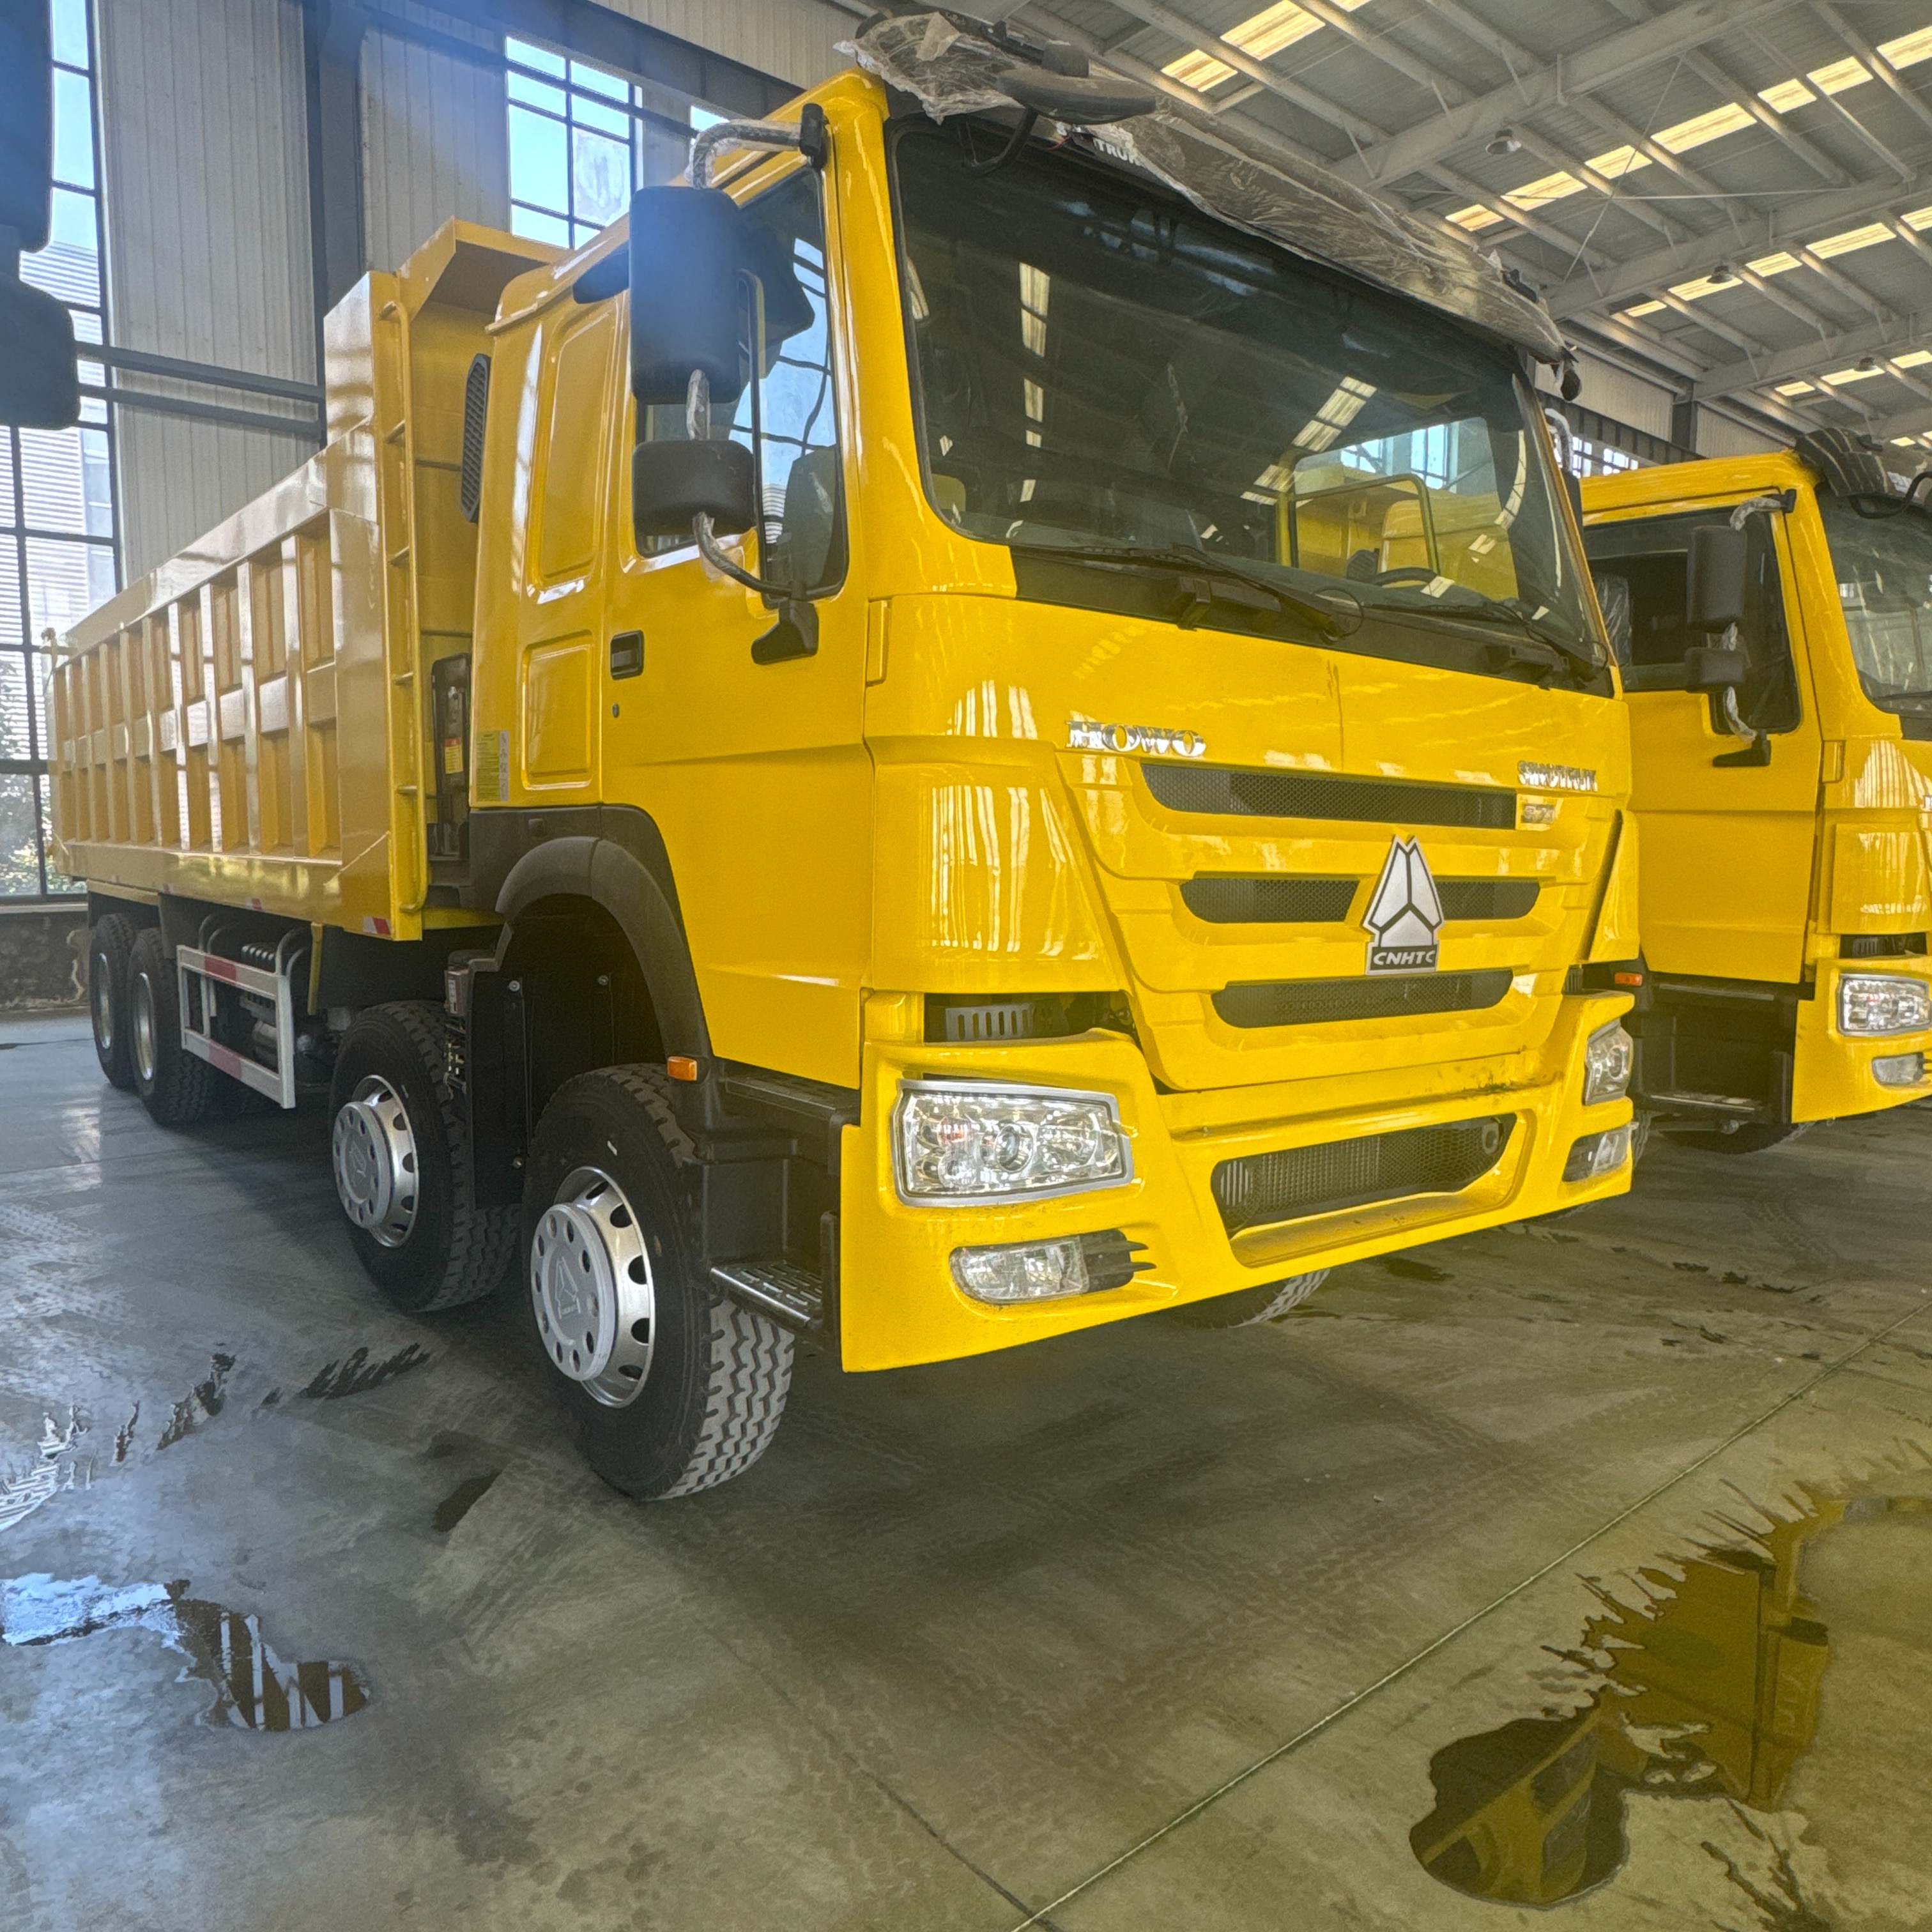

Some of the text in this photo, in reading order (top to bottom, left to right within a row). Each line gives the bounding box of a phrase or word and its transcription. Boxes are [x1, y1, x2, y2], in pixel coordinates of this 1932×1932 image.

[1093, 137, 1140, 165] TRUK
[1065, 721, 1206, 756] HOWO
[1374, 950, 1436, 965] CNHTC
